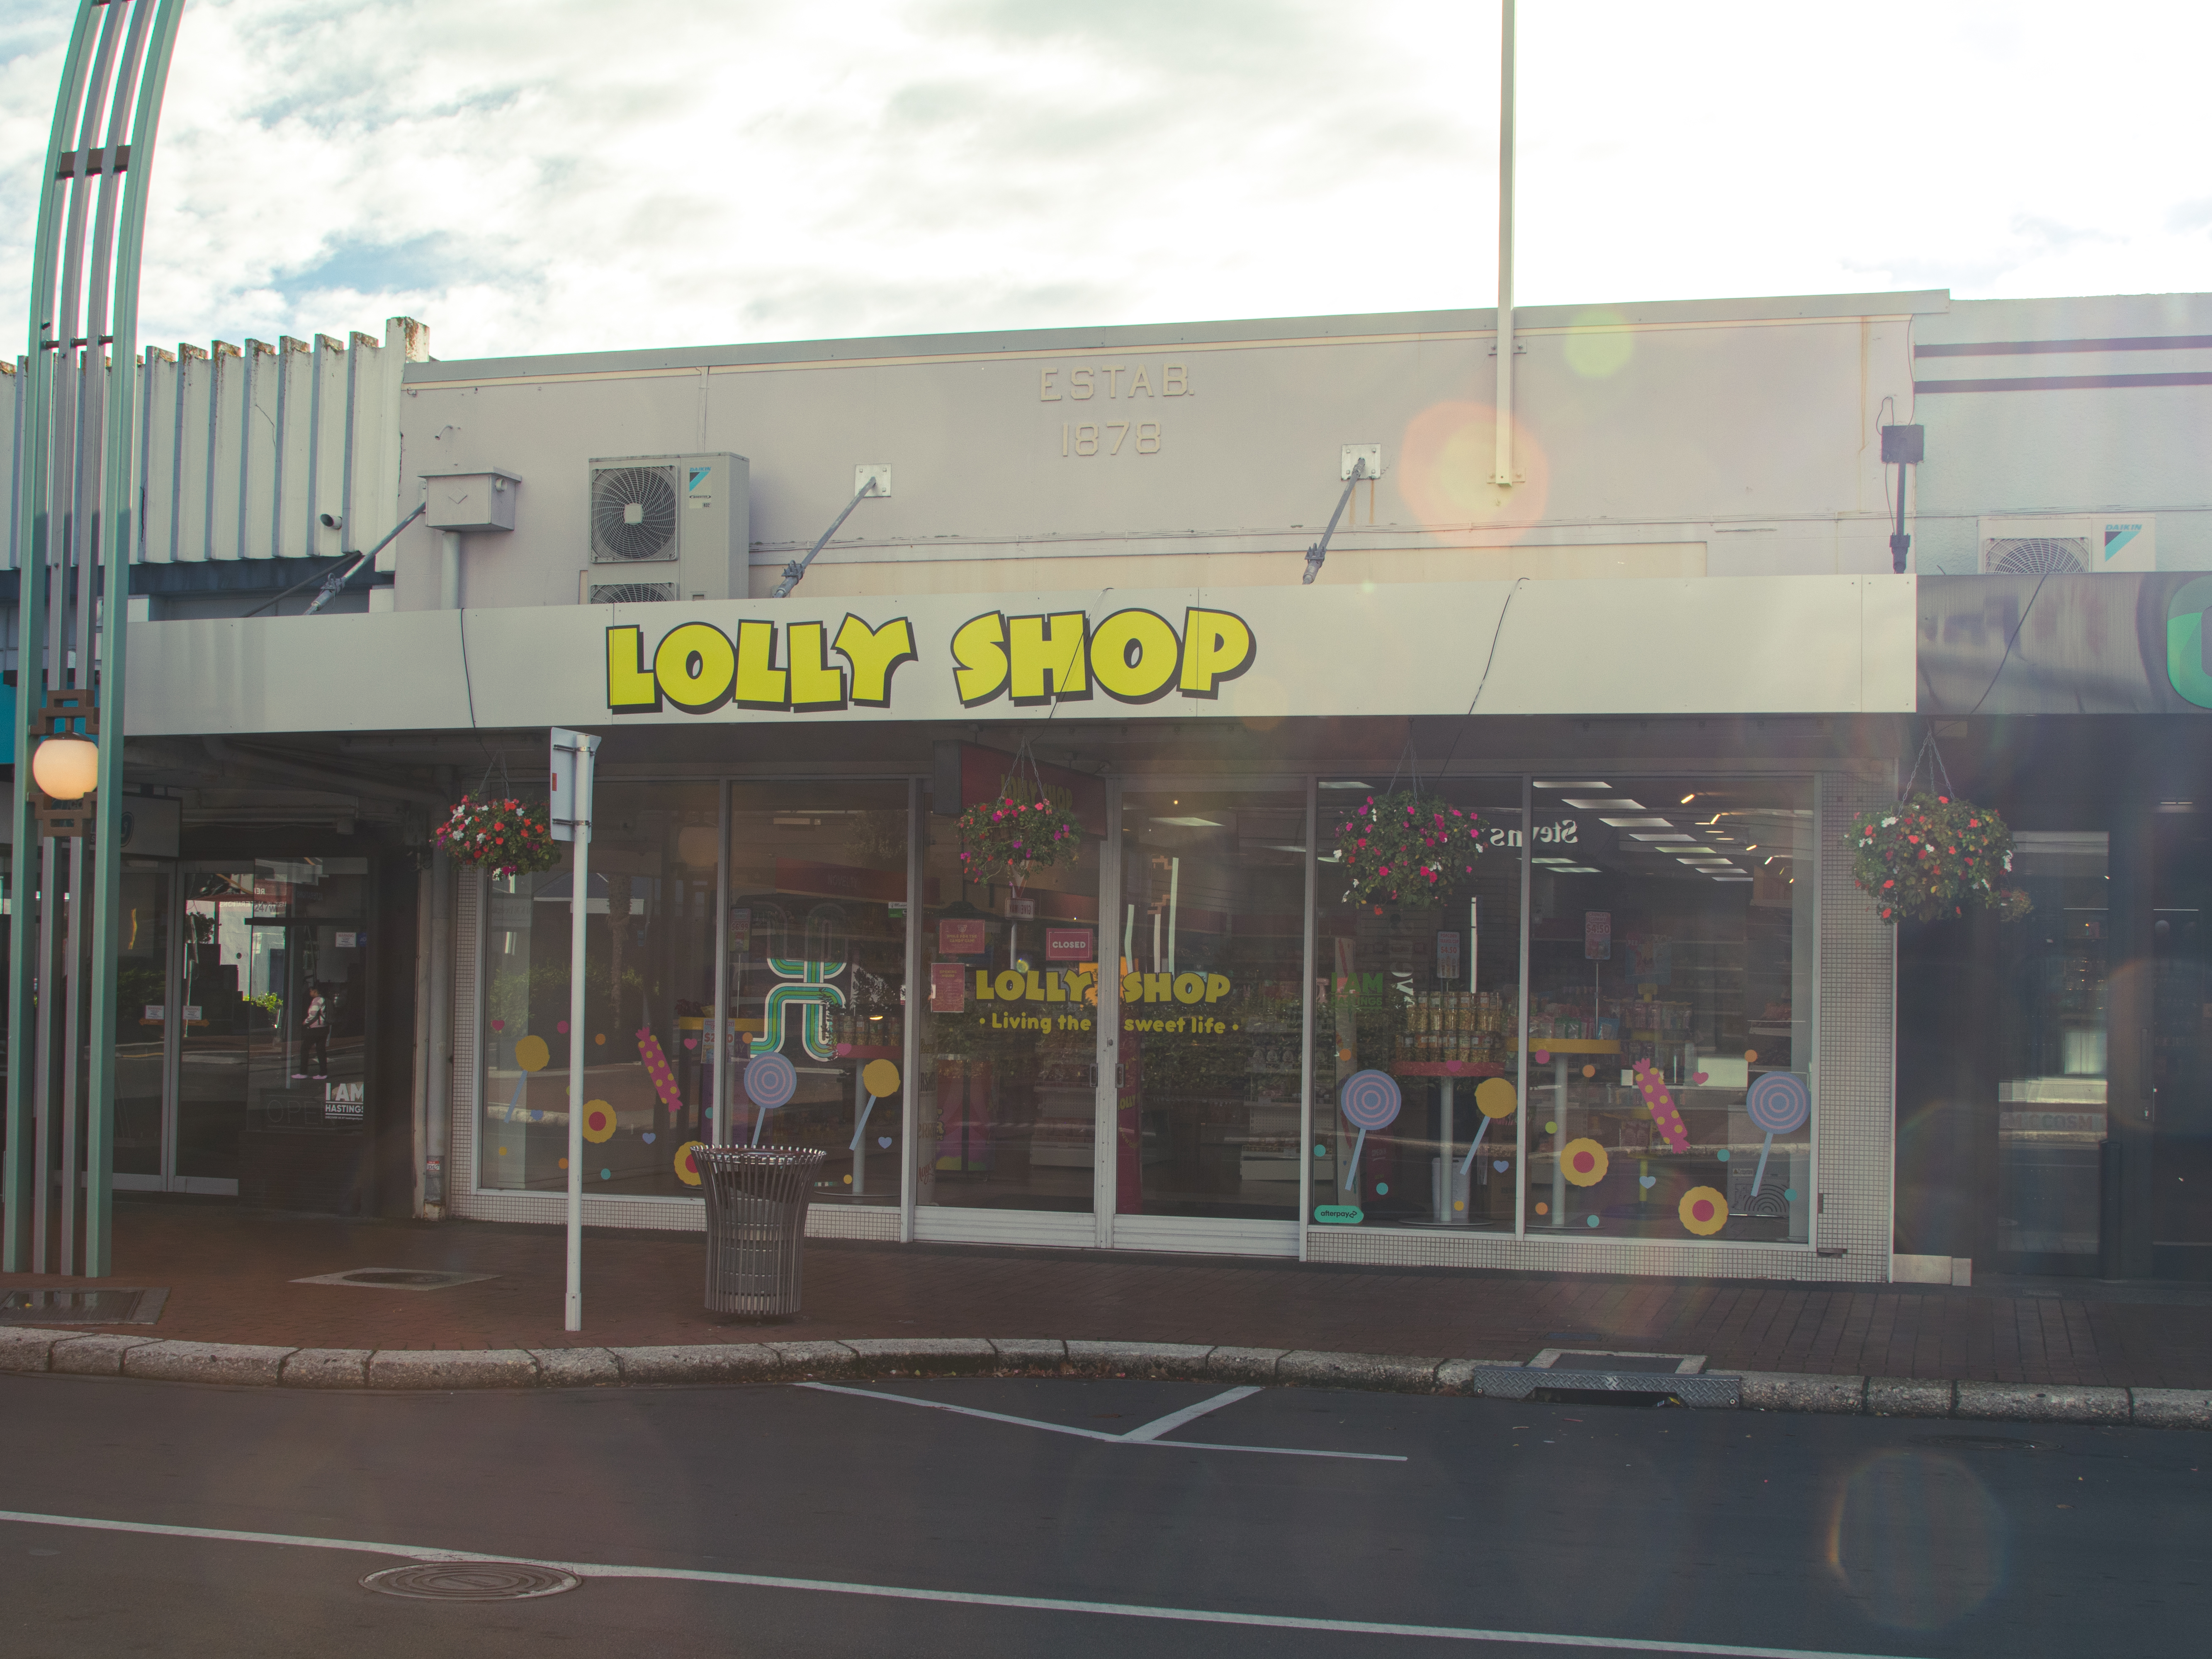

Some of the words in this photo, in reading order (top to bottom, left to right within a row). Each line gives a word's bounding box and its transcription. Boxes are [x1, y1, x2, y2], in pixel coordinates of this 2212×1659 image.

[1040, 363, 1195, 401] ESTAB.
[1062, 420, 1161, 457] 1878
[606, 612, 918, 715] LOLLY
[950, 608, 1257, 709] SHOP
[731, 922, 749, 931] $6.99
[1586, 924, 1609, 934] $4.50
[1052, 941, 1086, 949] CLOSED
[975, 968, 1095, 1004] LOLLY
[1122, 970, 1232, 1005] SHOP
[1331, 972, 1338, 992] I
[1343, 972, 1383, 993] AM
[992, 1012, 1052, 1034] Living
[1058, 1014, 1091, 1031] the
[1124, 1017, 1186, 1032] sweet
[1191, 1016, 1226, 1034] life
[325, 1082, 331, 1101] I
[335, 1083, 364, 1102] AM
[1320, 1210, 1350, 1219] afterpay
